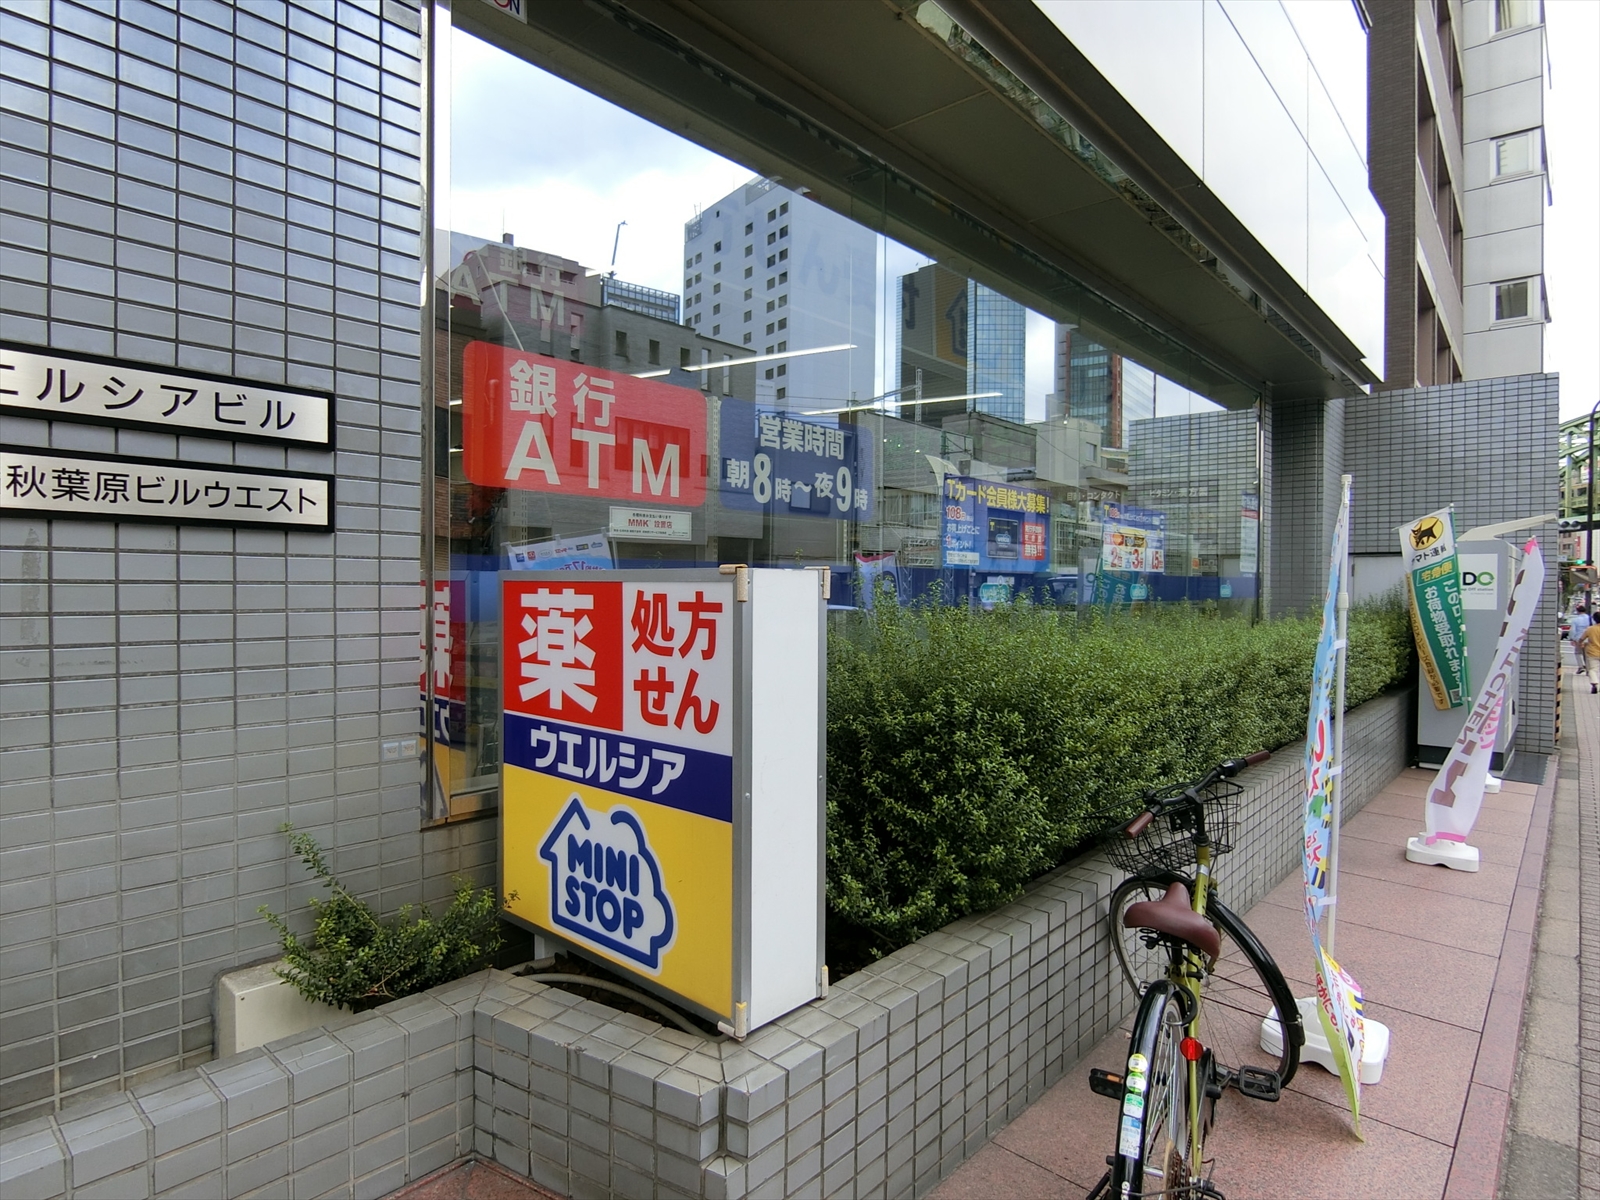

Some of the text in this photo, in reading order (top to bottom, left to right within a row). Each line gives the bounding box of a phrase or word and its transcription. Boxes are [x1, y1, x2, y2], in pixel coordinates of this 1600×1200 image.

[509, 359, 616, 428] 銀行
[504, 421, 681, 499] ATM
[759, 415, 845, 460] 営業時間
[6, 463, 319, 516] 秋葉原ビルウエスト
[628, 518, 649, 528] MMK
[1421, 561, 1453, 582] 宅急便
[518, 588, 598, 714] 薬
[631, 589, 724, 661] 処方
[633, 666, 720, 735] せん
[530, 724, 686, 796] ウエルシア
[567, 834, 640, 898] MINI
[565, 876, 645, 940] STOP
